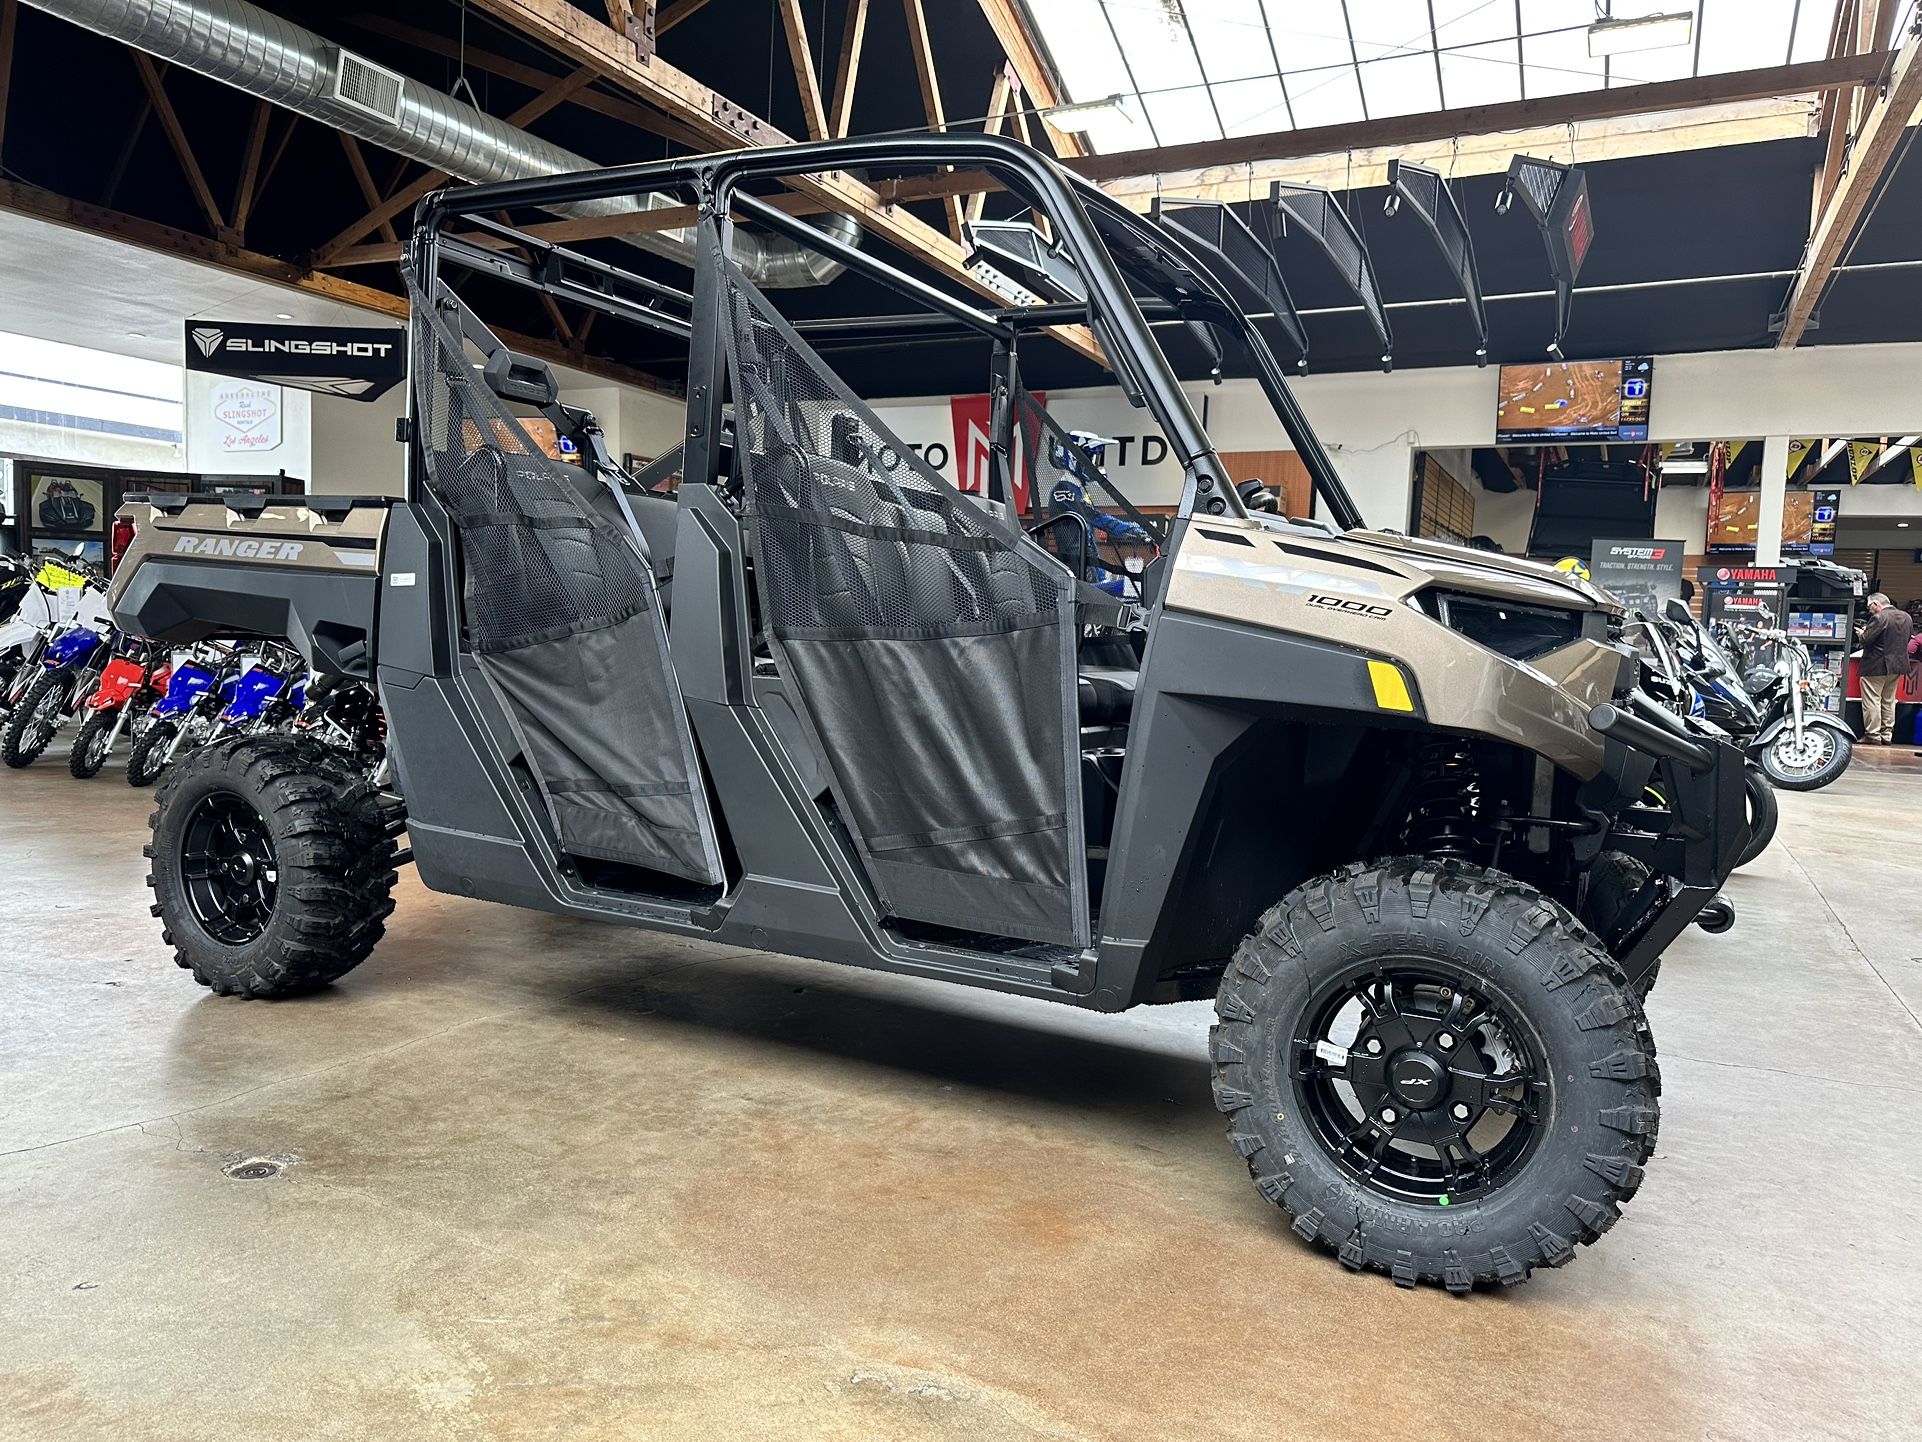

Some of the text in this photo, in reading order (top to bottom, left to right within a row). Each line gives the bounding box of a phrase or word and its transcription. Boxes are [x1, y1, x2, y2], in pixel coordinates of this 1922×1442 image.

[226, 339, 392, 357] SLINGSHOT
[223, 409, 267, 419] SLINGSHOT
[1848, 443, 1857, 480] DUNLOP
[174, 536, 304, 561] RANGER
[1731, 569, 1776, 580] YAMAHA
[1308, 595, 1392, 616] 1000
[1327, 607, 1367, 617] OVERHEAD
